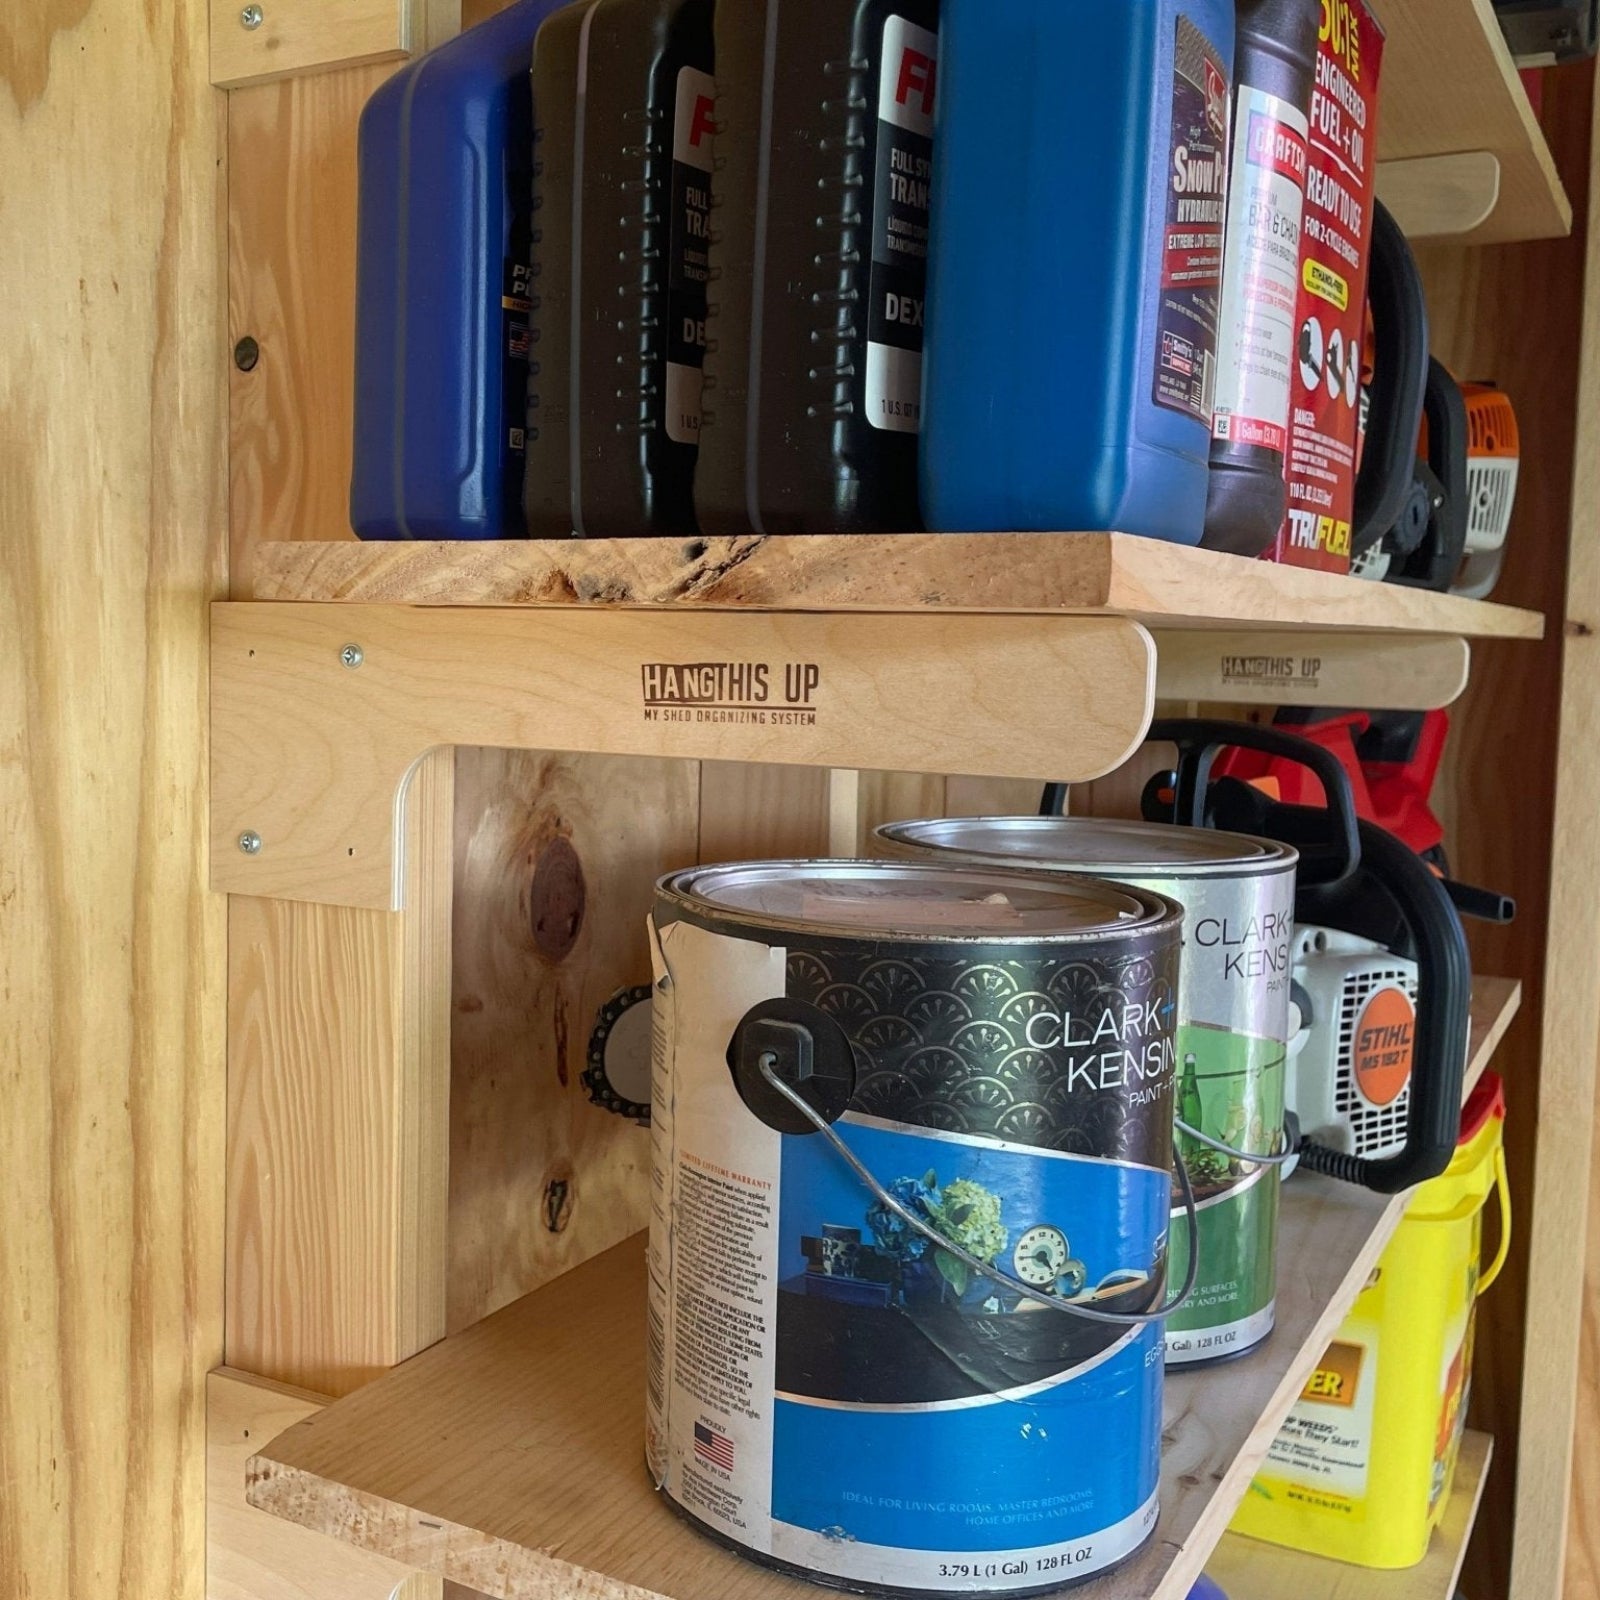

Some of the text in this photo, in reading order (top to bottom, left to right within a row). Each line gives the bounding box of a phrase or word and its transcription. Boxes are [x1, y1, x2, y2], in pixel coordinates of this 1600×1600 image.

[1315, 50, 1366, 130] ENGINEERED
[1310, 90, 1341, 148] FUEL
[1351, 128, 1364, 173] OIL
[891, 147, 915, 175] FULL
[686, 186, 708, 211] FULL
[1306, 165, 1339, 217] READY
[1338, 187, 1349, 226] TO
[1349, 197, 1361, 239] USE
[1305, 215, 1320, 241] FOR
[1288, 508, 1350, 556] TRUFUEL
[1301, 657, 1321, 677] UP
[785, 664, 819, 702] UP
[644, 709, 816, 726] MY SHED ORGANIZING SYSTEM
[1194, 910, 1288, 947] CLARK
[1025, 997, 1163, 1050] CLARK
[1359, 1023, 1411, 1053] STIHL
[702, 1161, 729, 1179] LIFETIME
[731, 1172, 772, 1191] WARRANTY
[1199, 1296, 1217, 1308] AND
[1218, 1294, 1238, 1304] MORE
[1201, 1280, 1238, 1296] SURFACES
[1171, 1331, 1237, 1351] Gal) 128 FL OZ
[842, 1491, 875, 1506] IDEAL
[878, 1497, 903, 1510] FOR
[906, 1499, 947, 1513] LIVING
[998, 1499, 1038, 1512] MASTER
[1041, 1489, 1093, 1508] BEDROOMS
[966, 1499, 1095, 1526] HOME OFFICES AND MORE
[939, 1547, 1093, 1578] 3.79 L (1 Gal) 128 FL OZ
